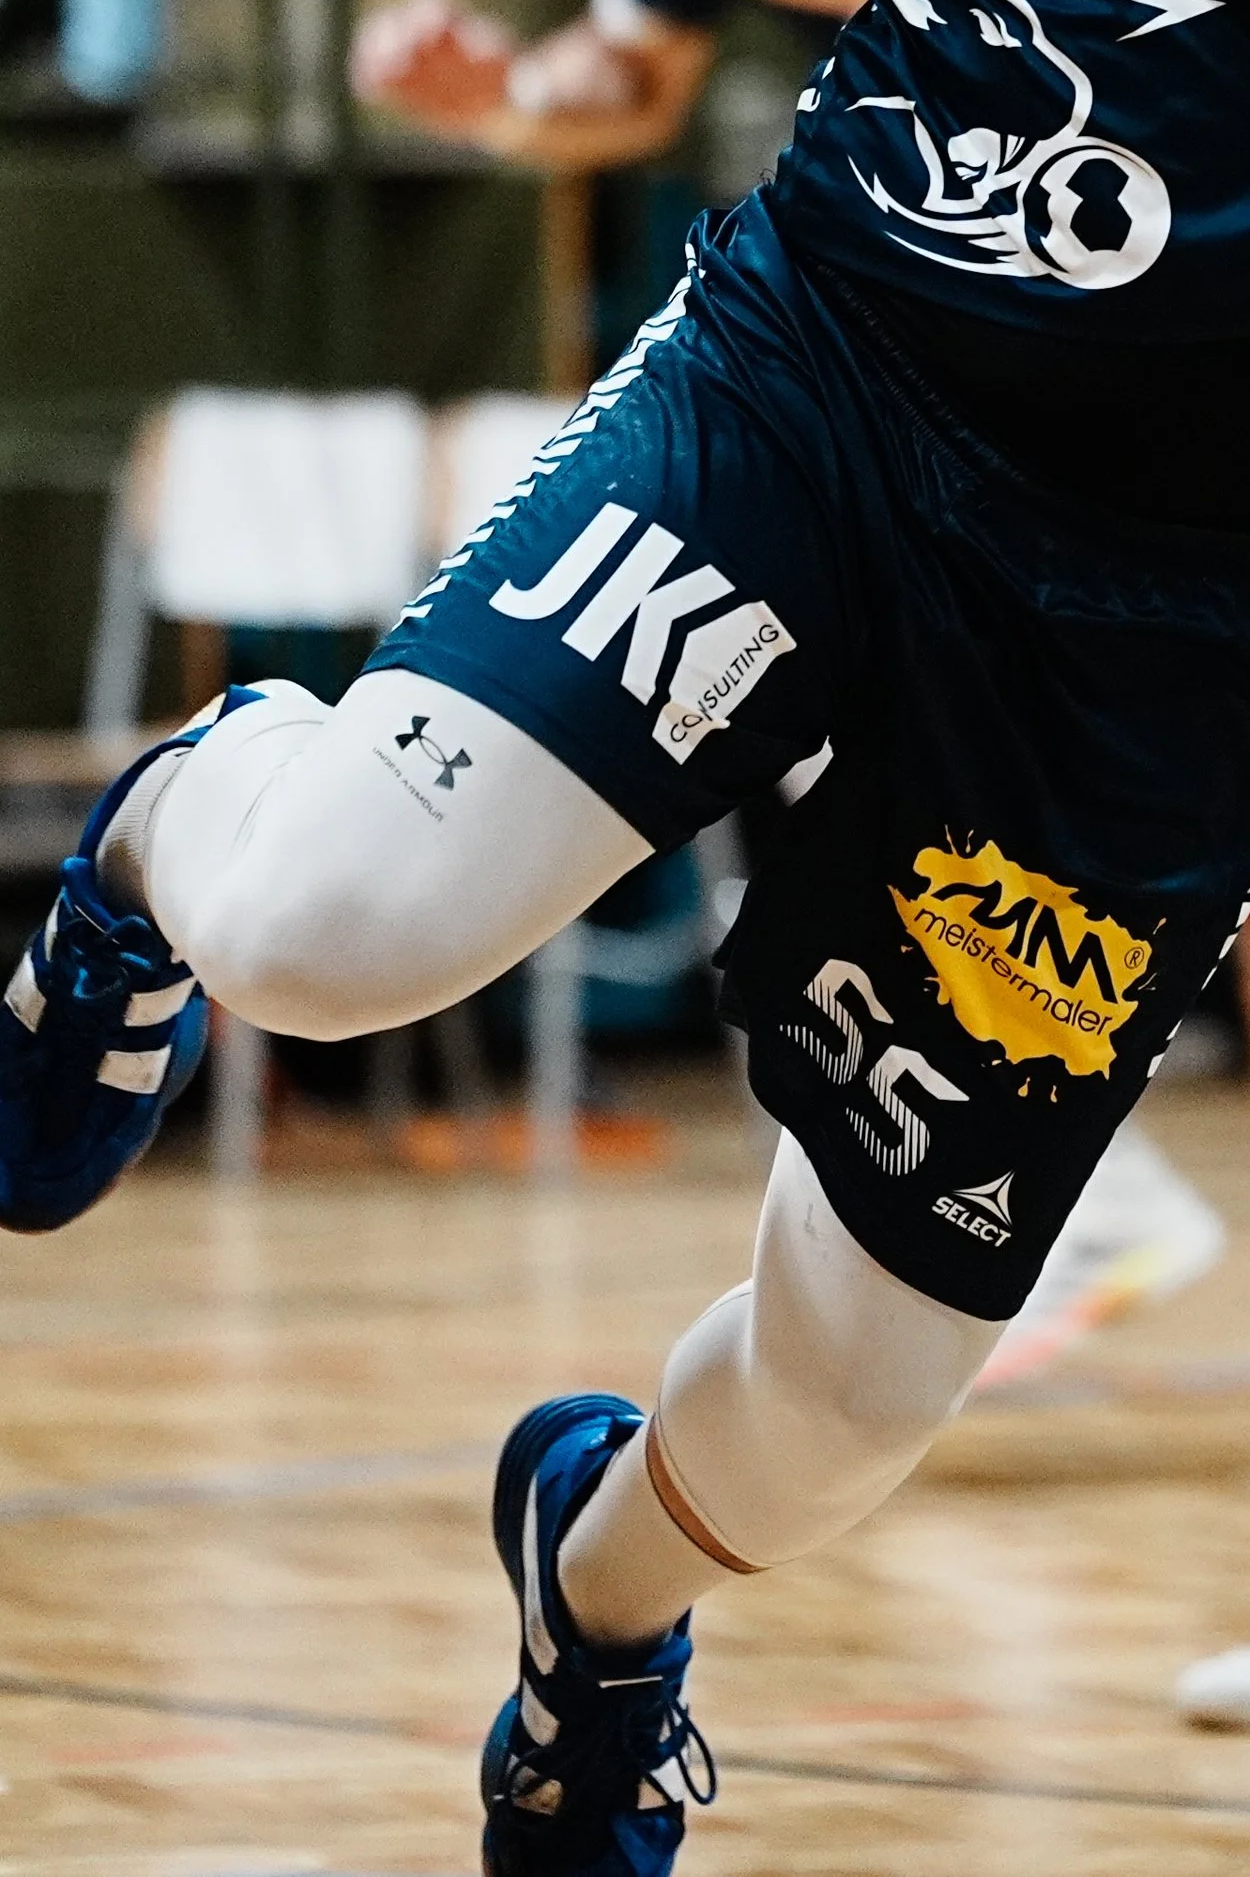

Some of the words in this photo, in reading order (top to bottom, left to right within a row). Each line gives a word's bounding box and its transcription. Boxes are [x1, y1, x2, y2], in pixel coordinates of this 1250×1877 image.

[372, 746, 402, 778] UNDER
[401, 779, 444, 822] ARMOUR
[914, 908, 1113, 1035] meistermaler
[932, 1196, 1012, 1247] SELECT
